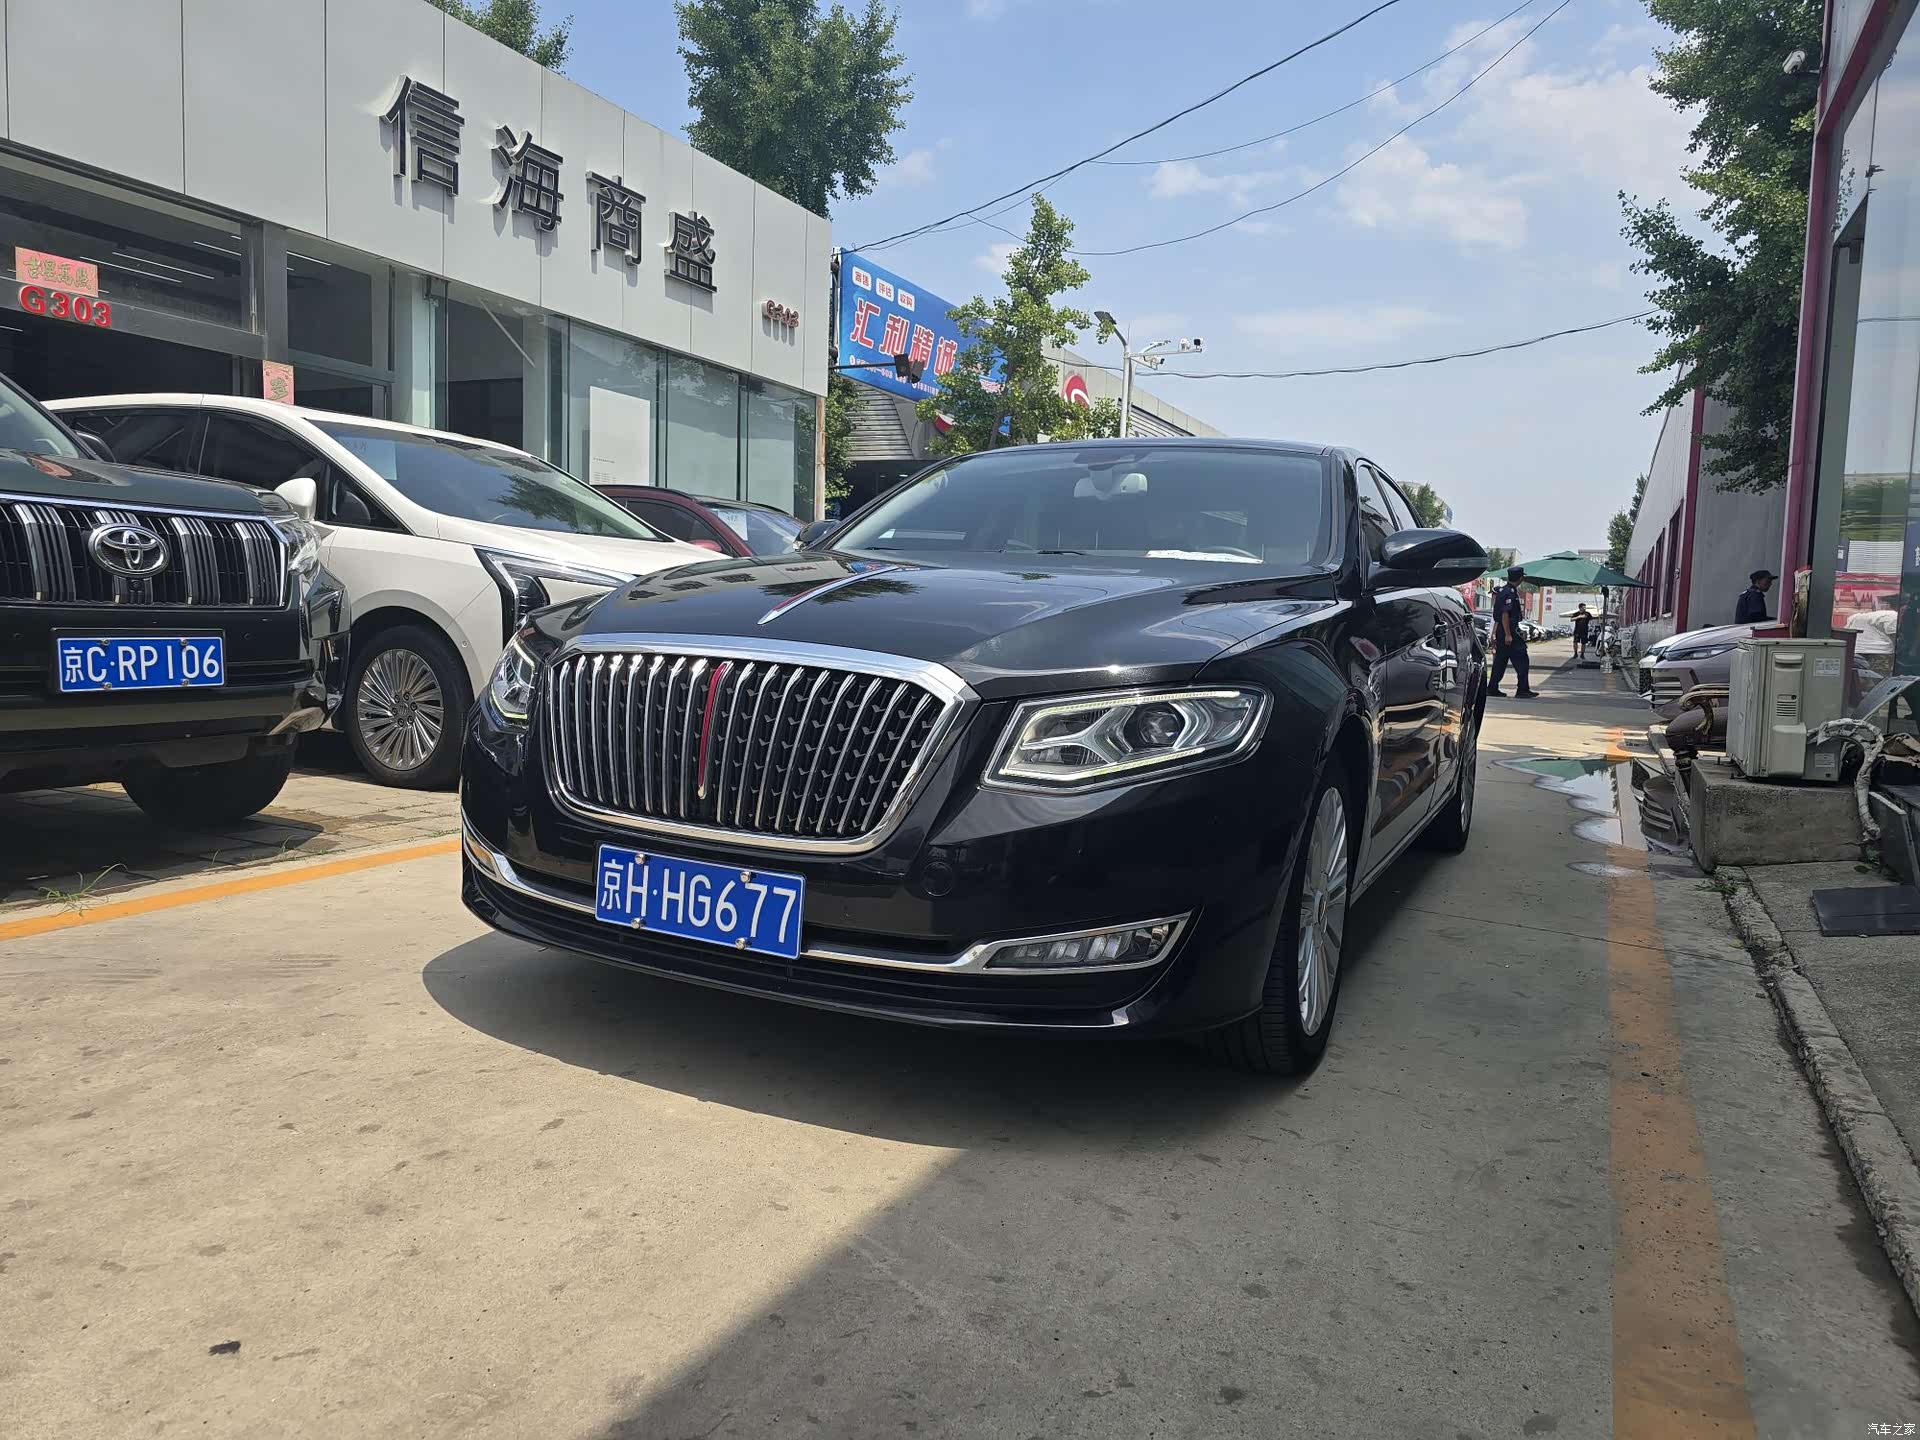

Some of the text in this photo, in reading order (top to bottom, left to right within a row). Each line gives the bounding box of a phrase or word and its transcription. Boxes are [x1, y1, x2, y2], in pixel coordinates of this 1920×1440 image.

[378, 73, 718, 293] 信海商盛
[18, 285, 112, 328] G303
[878, 283, 892, 298] 评估
[900, 293, 913, 308] 收购
[850, 298, 958, 376] 汇利精诚
[63, 645, 220, 683] 京C·RP106
[601, 859, 797, 944] 京H·HG677
